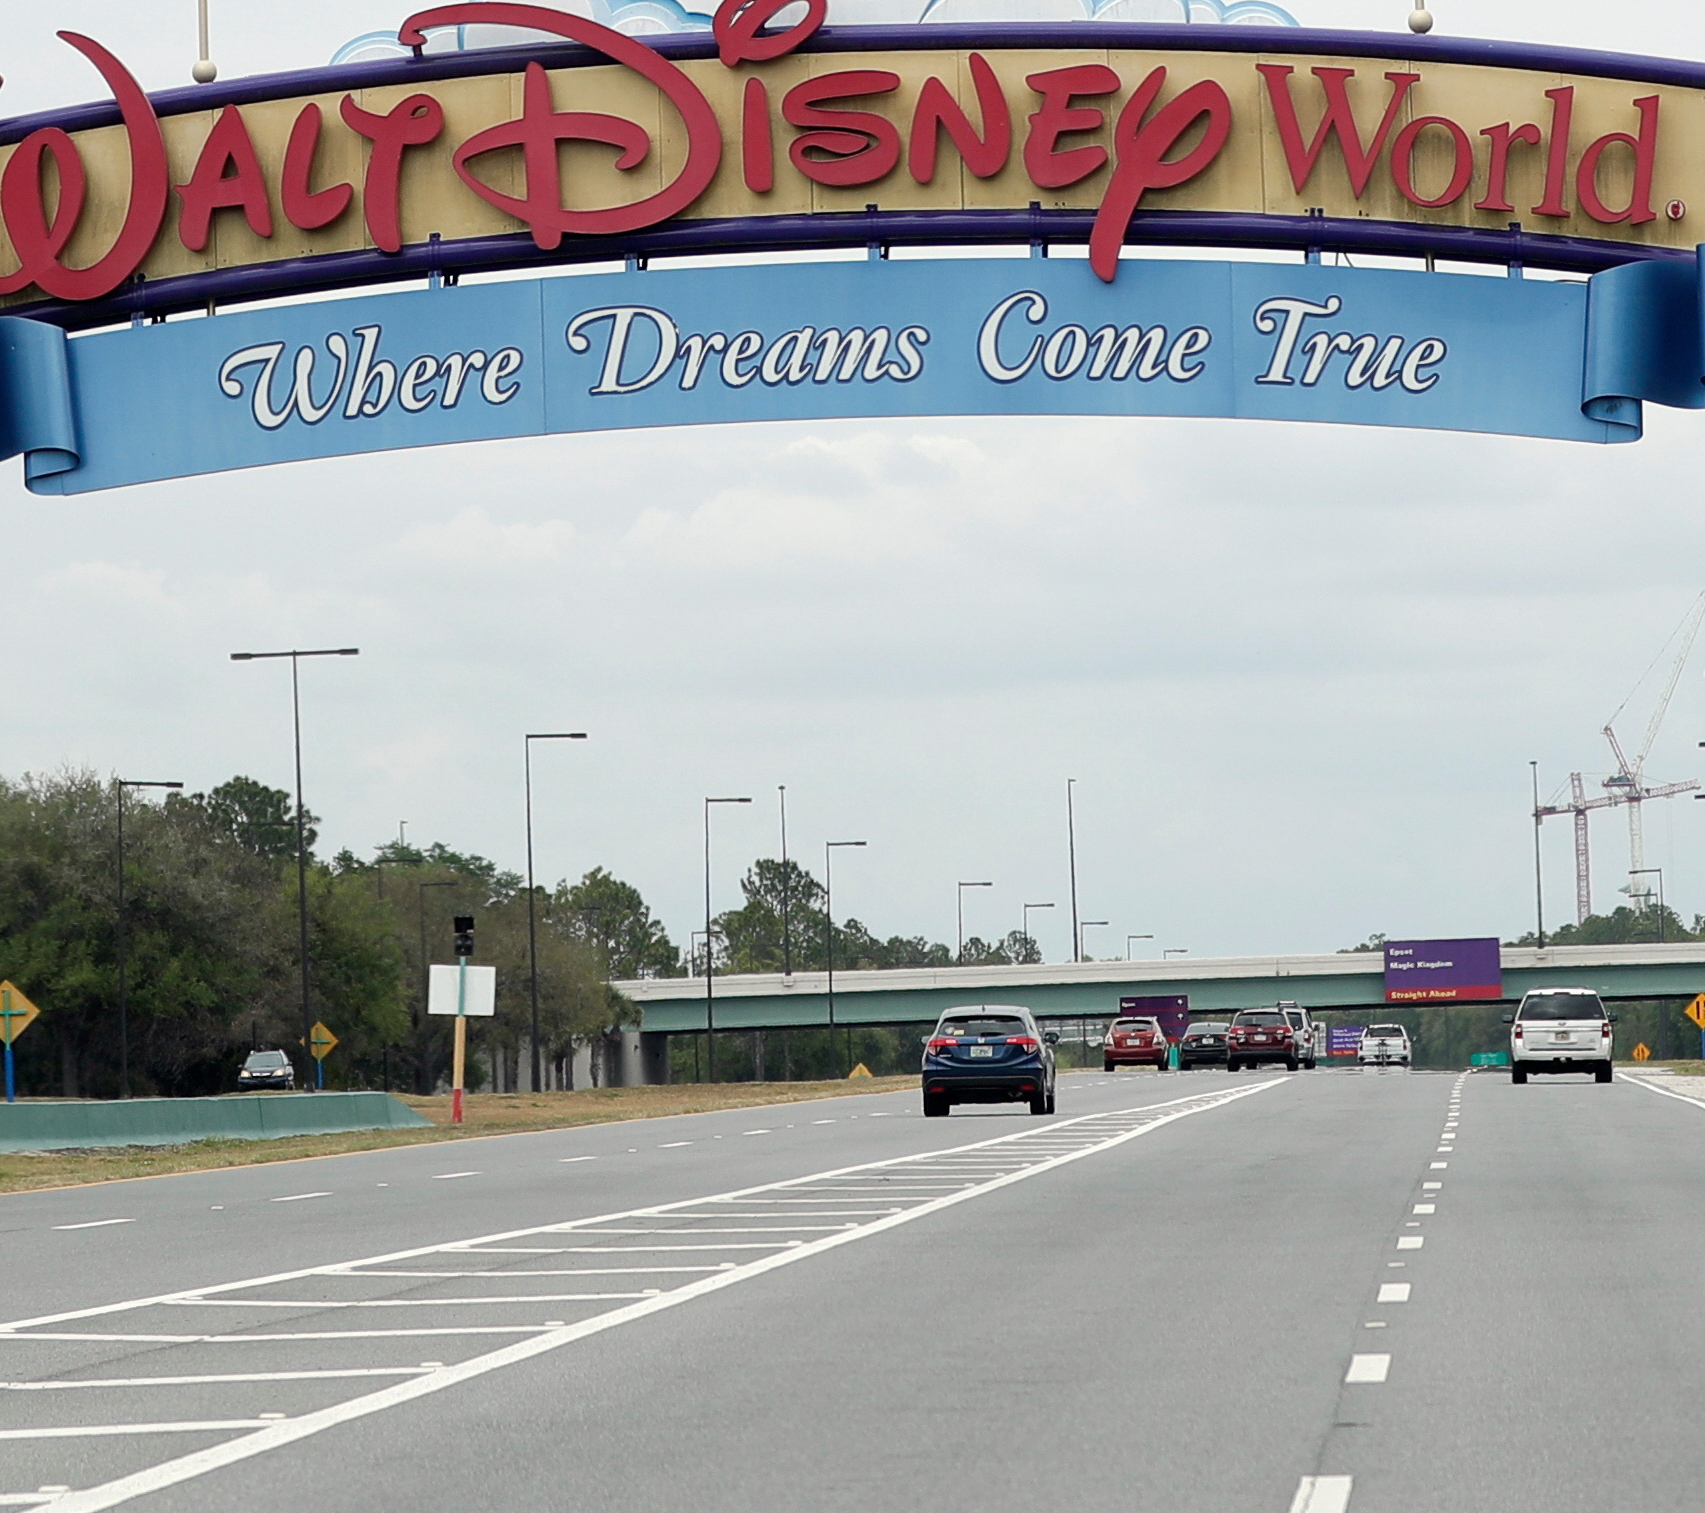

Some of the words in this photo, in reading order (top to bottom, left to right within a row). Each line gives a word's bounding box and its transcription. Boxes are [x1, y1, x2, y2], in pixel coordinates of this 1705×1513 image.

[1254, 61, 1660, 226] World
[218, 322, 524, 431] Where
[565, 304, 930, 396] Dreams
[976, 289, 1212, 384] Come
[1251, 295, 1448, 392] True
[1389, 962, 1415, 971] Magic
[1416, 961, 1453, 969] Kingdom
[1391, 991, 1426, 1000] Straight
[1428, 990, 1456, 998] Ahead
